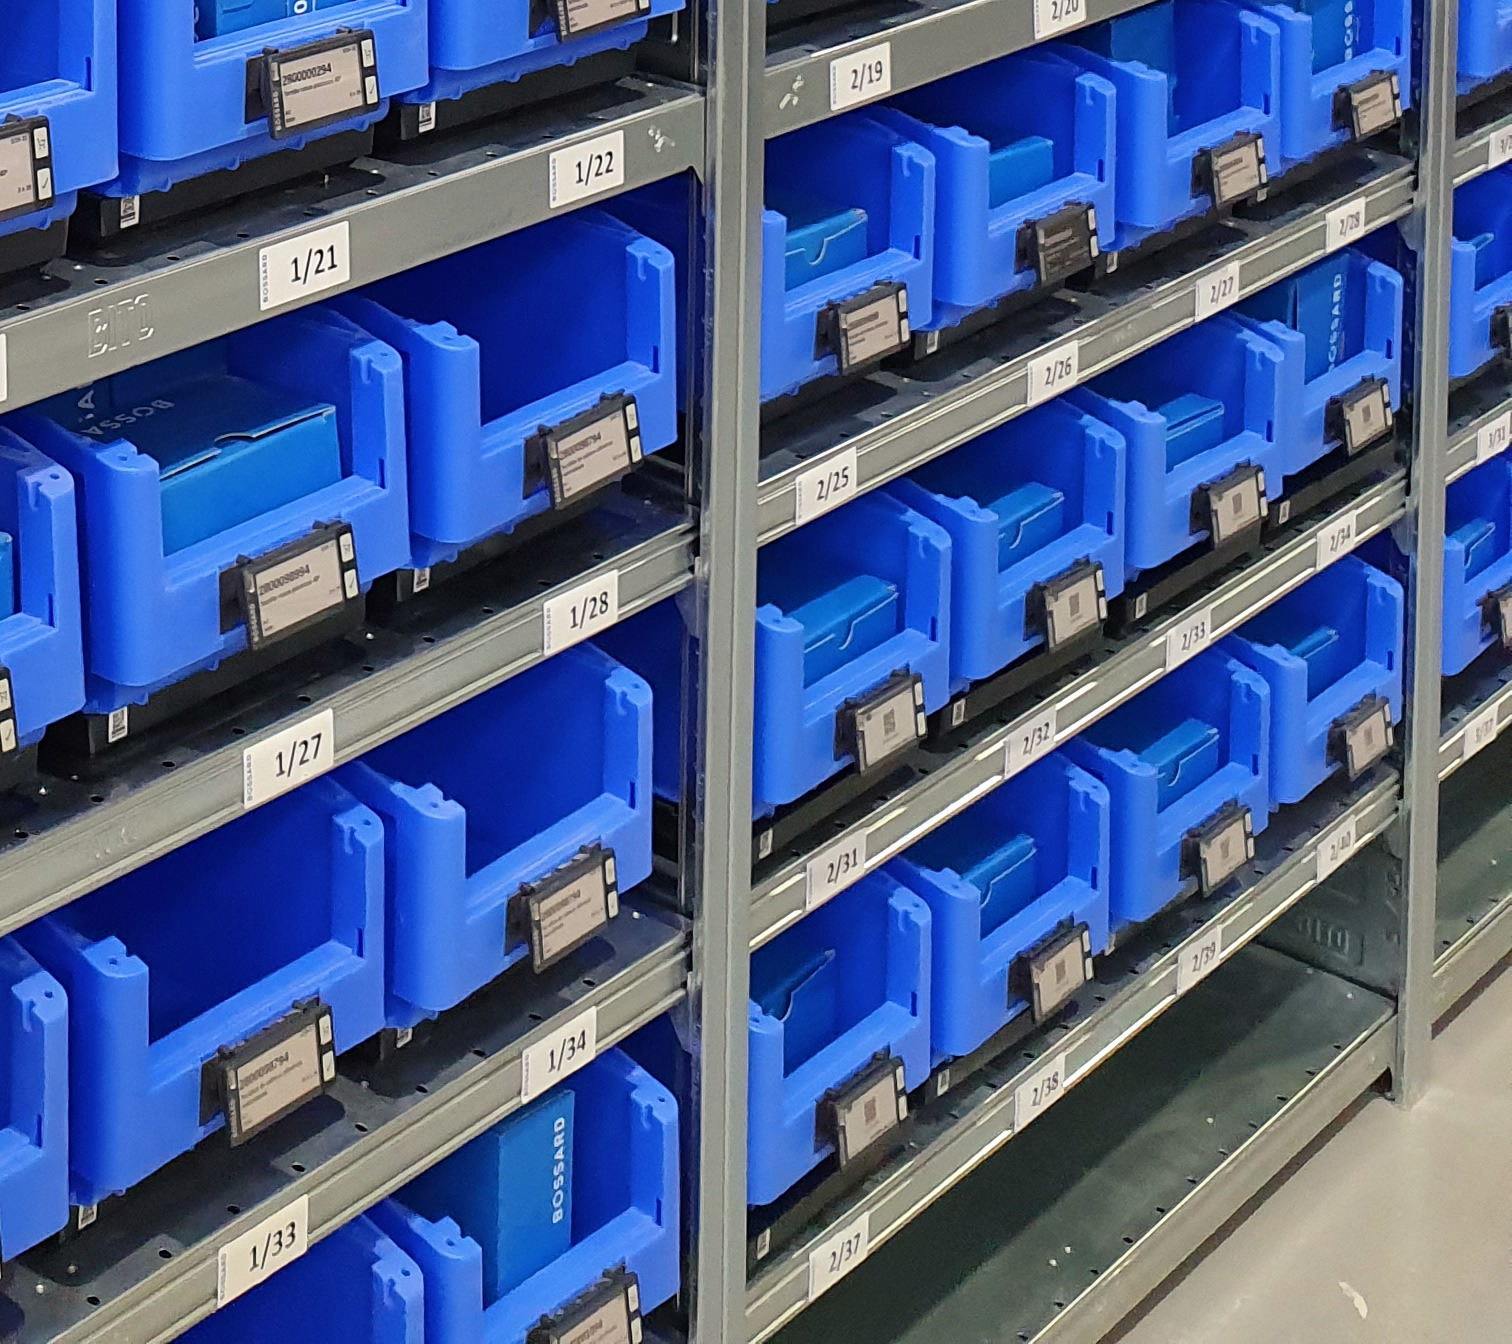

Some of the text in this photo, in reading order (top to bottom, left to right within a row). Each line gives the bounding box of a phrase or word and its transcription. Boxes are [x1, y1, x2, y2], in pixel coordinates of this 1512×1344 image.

[852, 60, 882, 91] 2/19
[576, 150, 613, 187] 1/22
[291, 244, 337, 286] 1/21
[1210, 276, 1233, 304] 2/27
[1045, 356, 1071, 386] 2/26
[817, 466, 849, 502] 2/25
[570, 591, 609, 630] 1/28
[1182, 623, 1205, 651] 2/33
[276, 733, 321, 778] 1/27
[1023, 723, 1050, 755] 2/32
[827, 849, 858, 883] 2/31
[548, 1029, 587, 1073] 1/34
[1032, 1072, 1059, 1107] 2/38
[552, 1117, 565, 1224] BOSSARD
[249, 1222, 296, 1272] 1/33
[829, 1233, 860, 1272] 2/37
